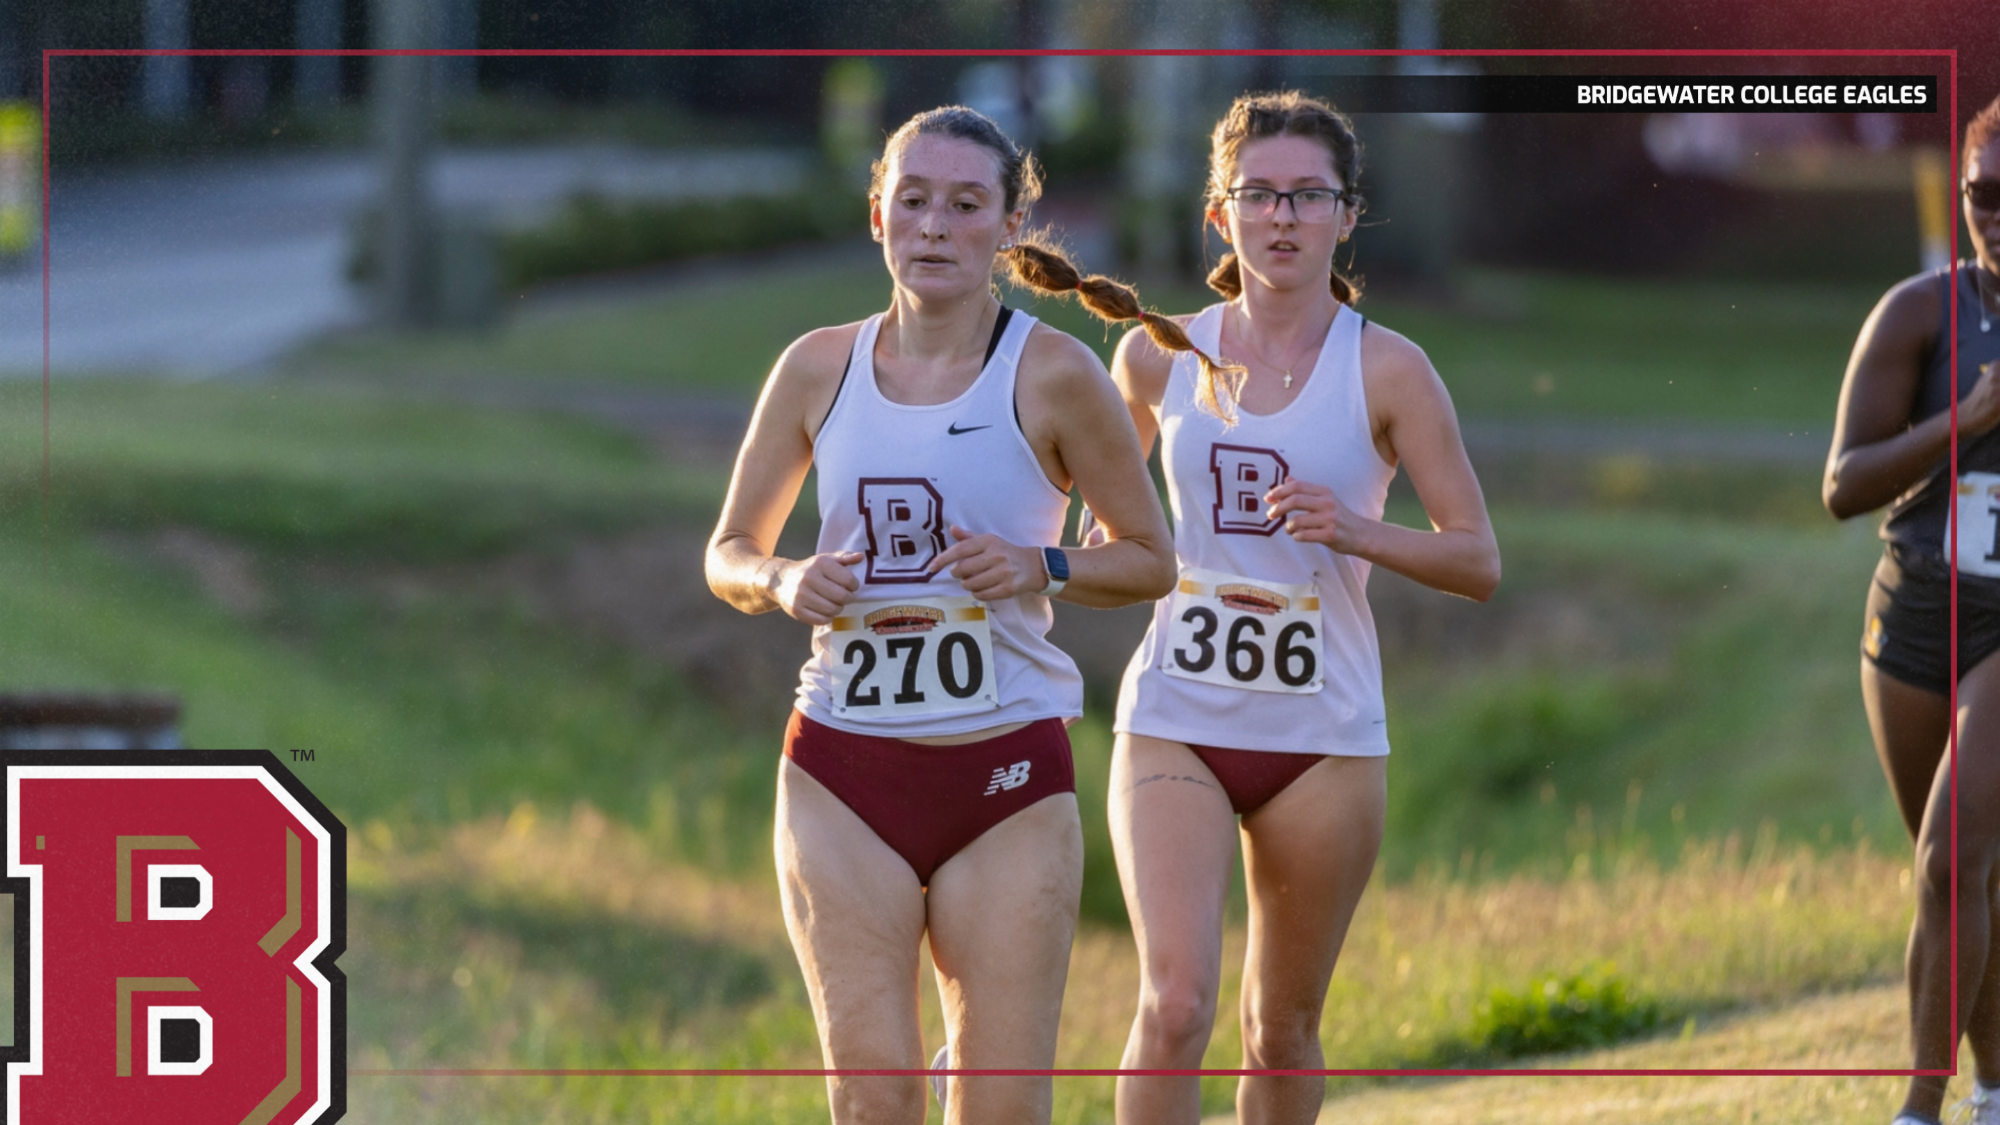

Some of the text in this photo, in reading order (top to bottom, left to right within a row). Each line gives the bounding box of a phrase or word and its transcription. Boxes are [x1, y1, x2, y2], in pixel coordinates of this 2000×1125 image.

[1210, 442, 1289, 537] B
[858, 477, 947, 584] B
[864, 605, 944, 628] BRIDGEWATER
[1173, 605, 1317, 687] 366
[843, 631, 984, 708] 270
[983, 760, 1032, 796] NB
